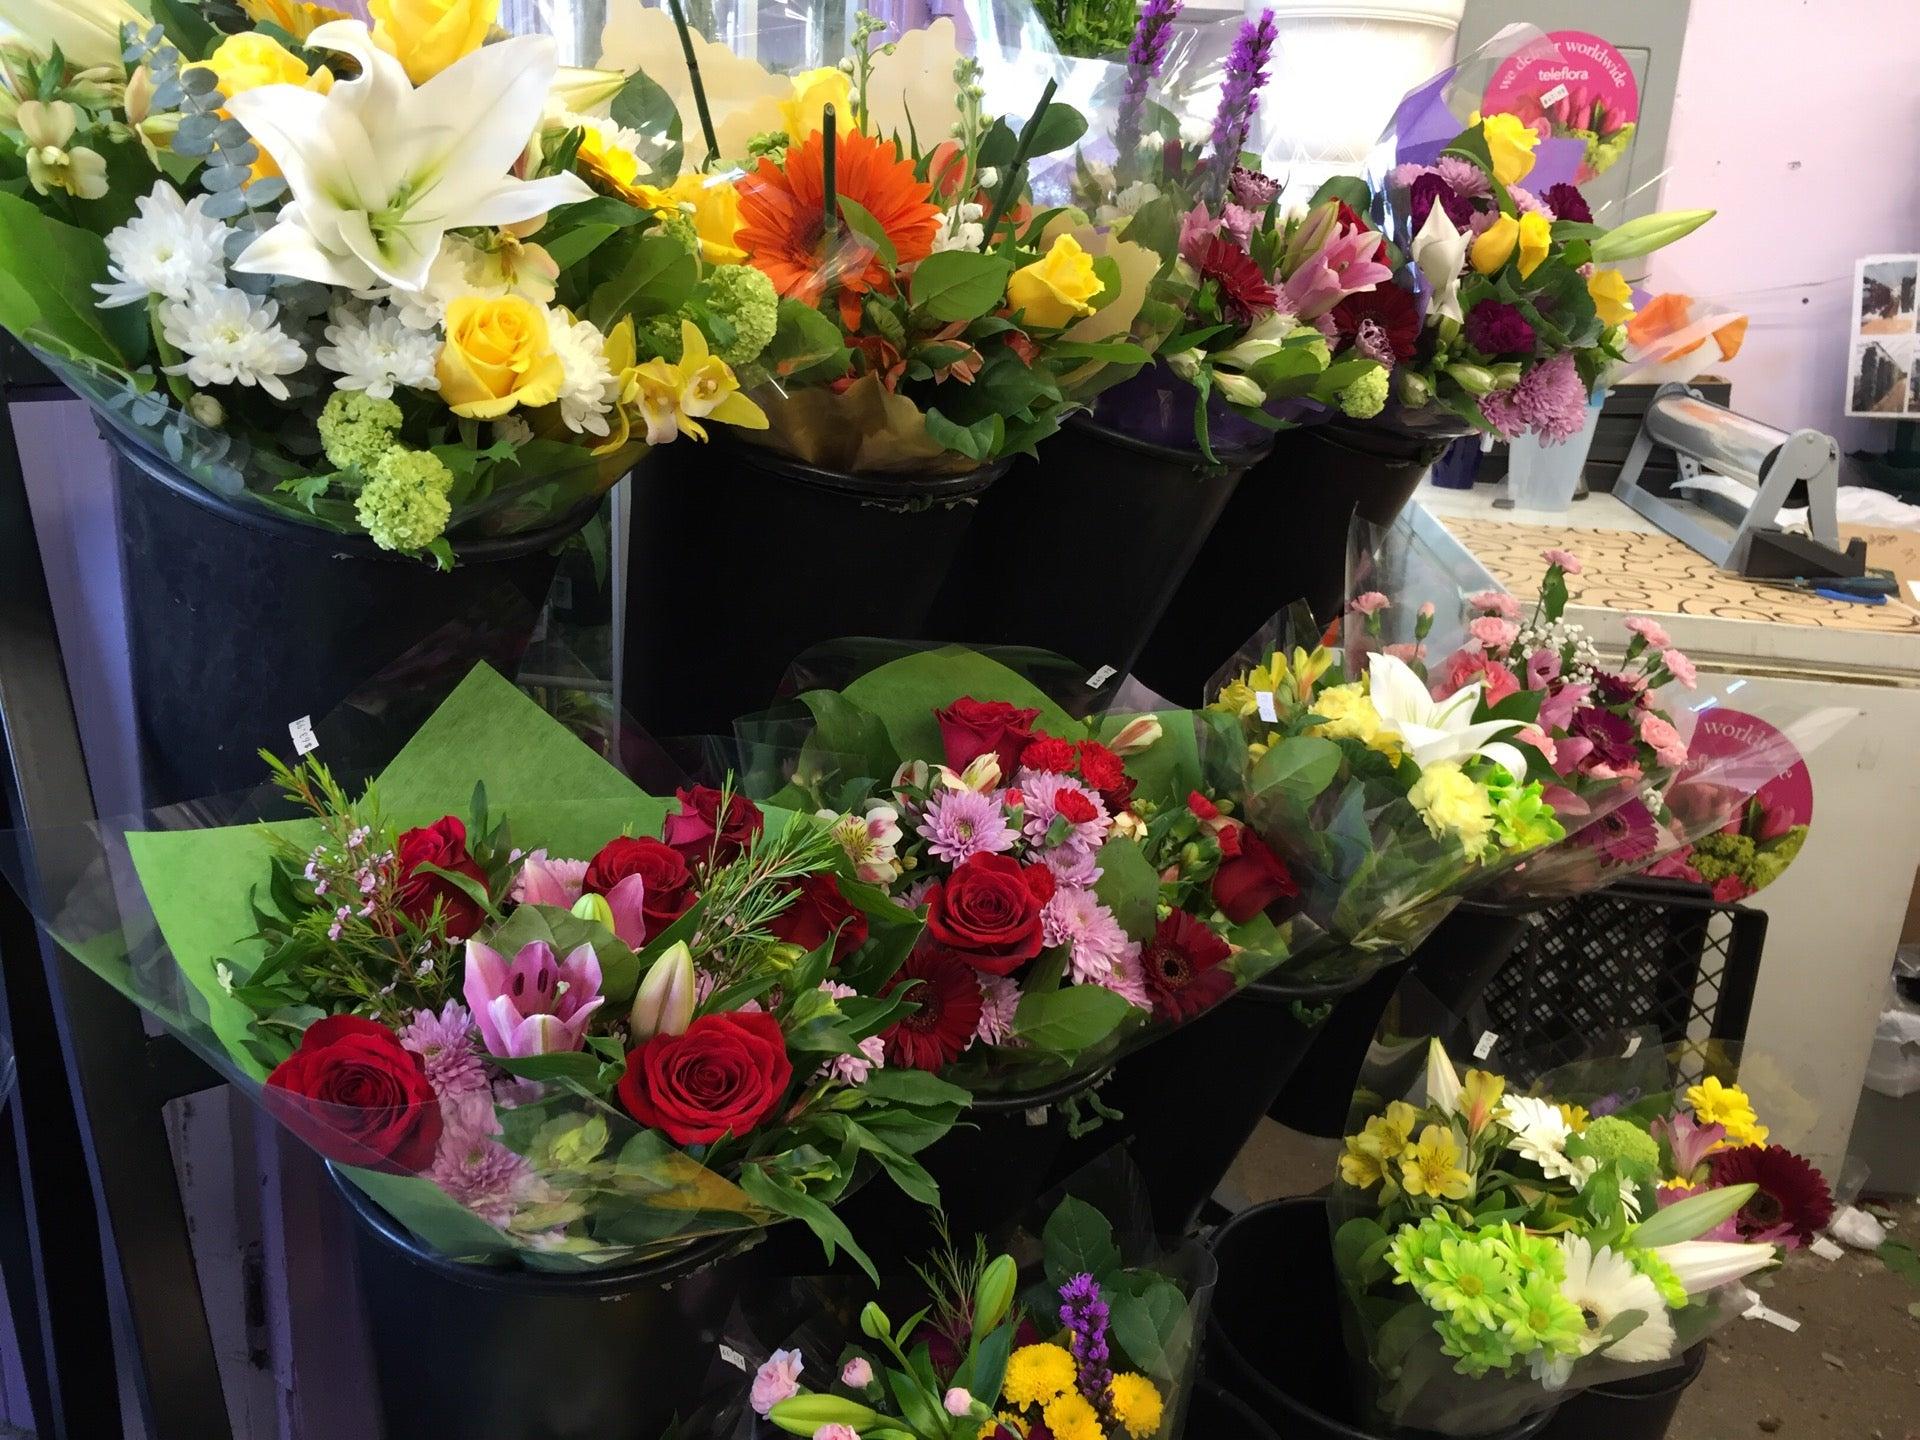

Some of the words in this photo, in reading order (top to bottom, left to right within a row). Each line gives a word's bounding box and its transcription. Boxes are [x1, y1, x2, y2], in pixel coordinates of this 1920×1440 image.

[1499, 69, 1517, 91] we
[1566, 41, 1627, 89] worldwide
[1538, 66, 1589, 82] teleflora
[1704, 721, 1793, 781] worlde
